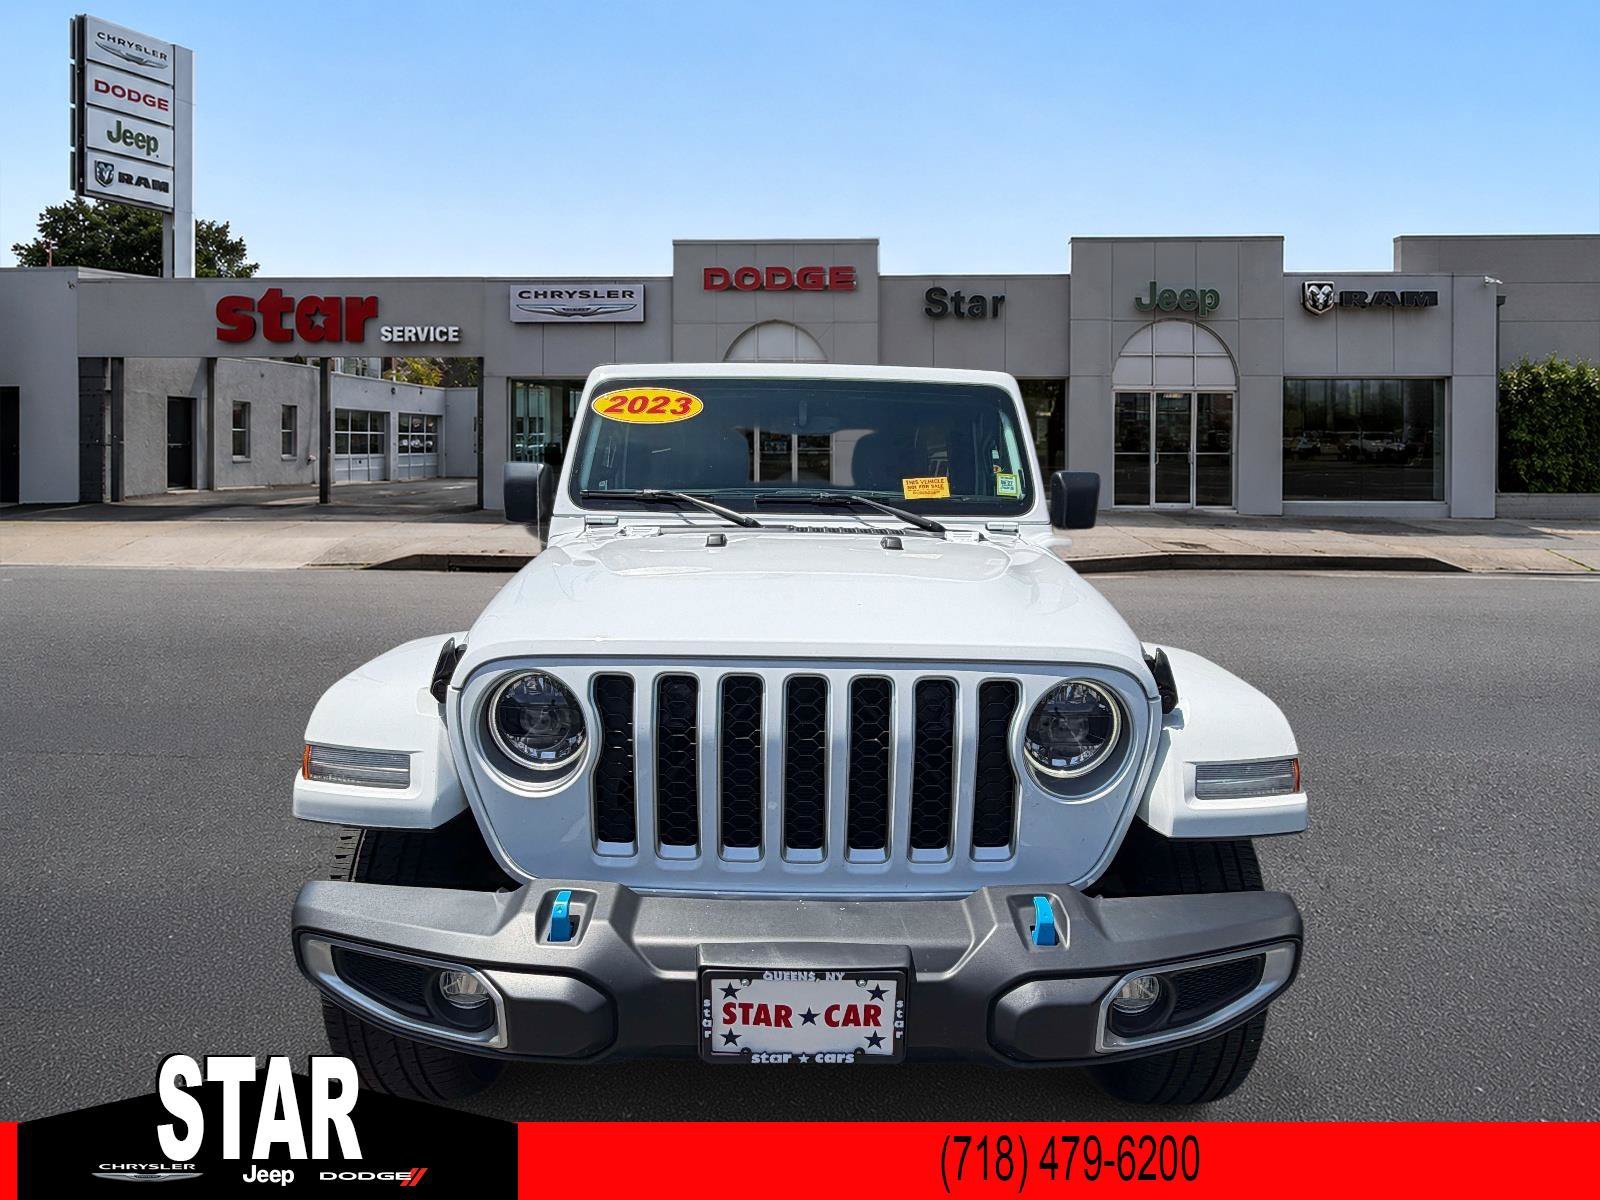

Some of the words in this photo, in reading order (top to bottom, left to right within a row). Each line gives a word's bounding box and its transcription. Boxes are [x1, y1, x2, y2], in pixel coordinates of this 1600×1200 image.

[97, 32, 168, 61] CHRYSLER
[94, 79, 169, 111] DODGE
[107, 120, 159, 156] Jeep
[118, 171, 169, 193] RAM
[703, 266, 857, 291] DODGE
[518, 290, 635, 299] CHRYSLER
[924, 287, 1006, 320] Star
[1135, 281, 1220, 316] Jeep
[1339, 290, 1439, 309] RAM
[216, 288, 379, 343] star
[380, 326, 461, 343] SERVICE
[603, 395, 693, 415] 2023
[763, 971, 821, 982] QUEENS,
[825, 971, 846, 981] NY
[722, 1002, 793, 1028] STAR
[824, 1004, 882, 1028] CAR
[751, 1052, 792, 1064] star
[815, 1052, 855, 1064] cars
